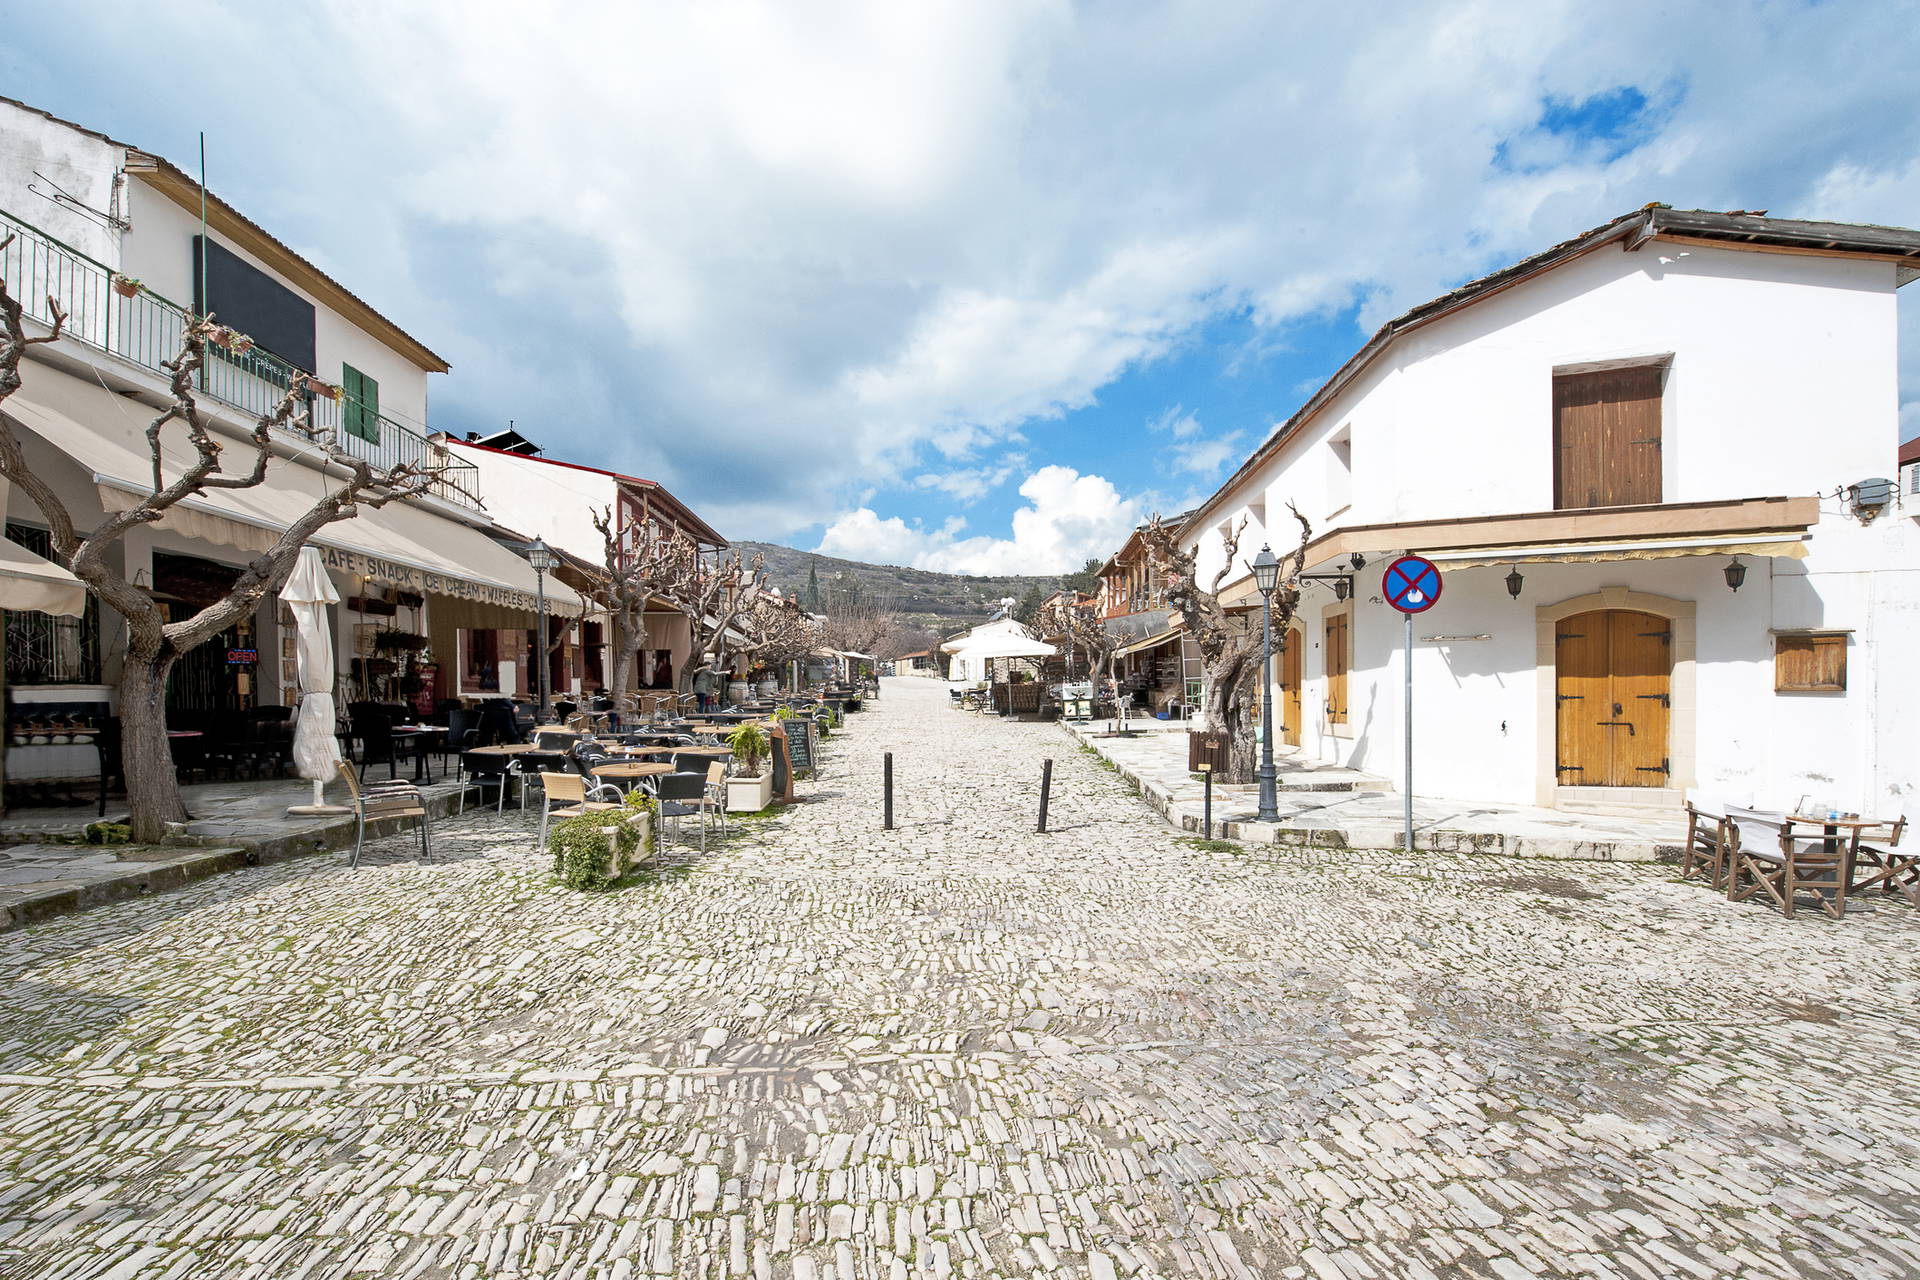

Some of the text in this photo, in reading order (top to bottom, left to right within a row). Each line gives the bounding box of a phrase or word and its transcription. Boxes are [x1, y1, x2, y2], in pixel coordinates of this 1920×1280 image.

[319, 547, 552, 612] CAFE SNACK ICE CREAM WAFFLES CAES
[228, 651, 257, 661] OPEN
